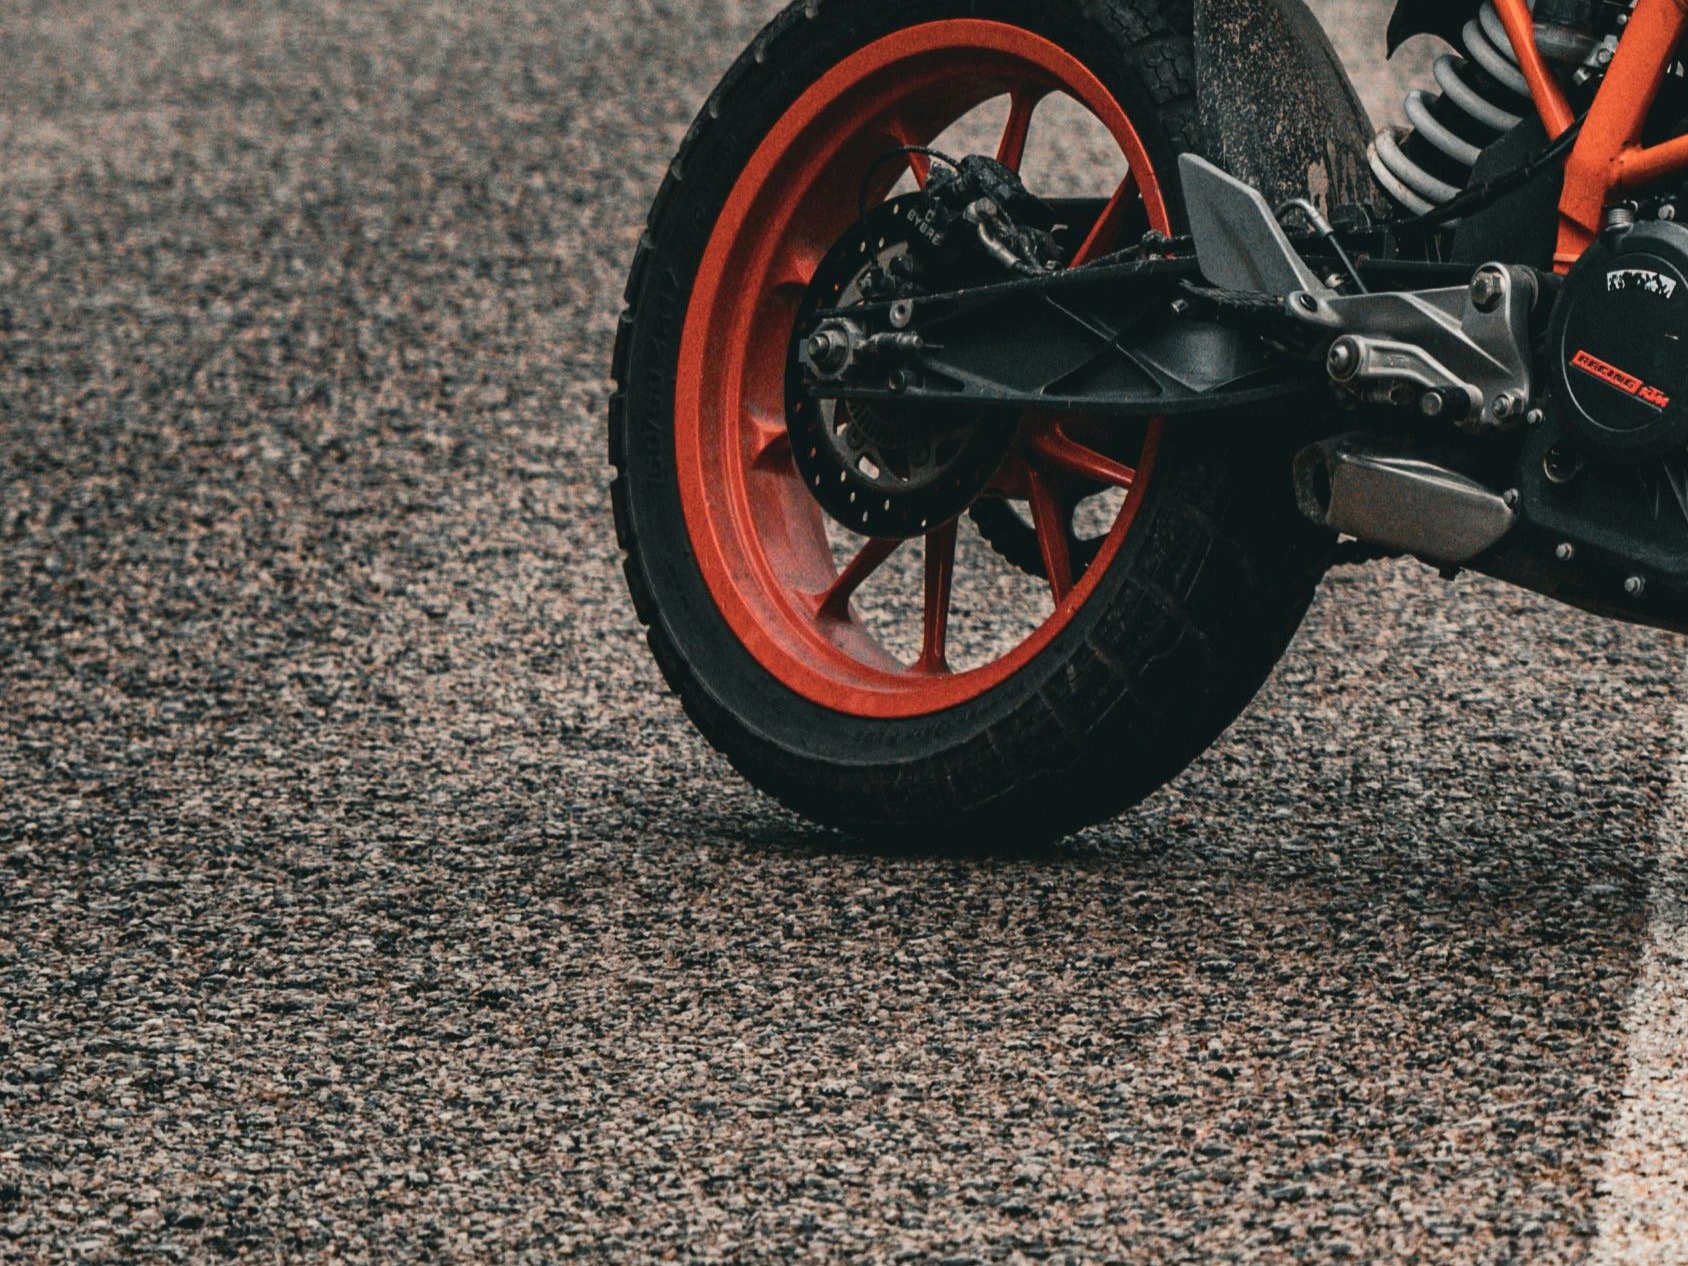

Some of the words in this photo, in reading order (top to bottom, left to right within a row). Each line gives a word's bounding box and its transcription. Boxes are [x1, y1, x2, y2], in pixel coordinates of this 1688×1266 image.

[907, 208, 944, 245] BYBRE
[1577, 353, 1637, 391] RACING
[1637, 385, 1671, 409] KTM
